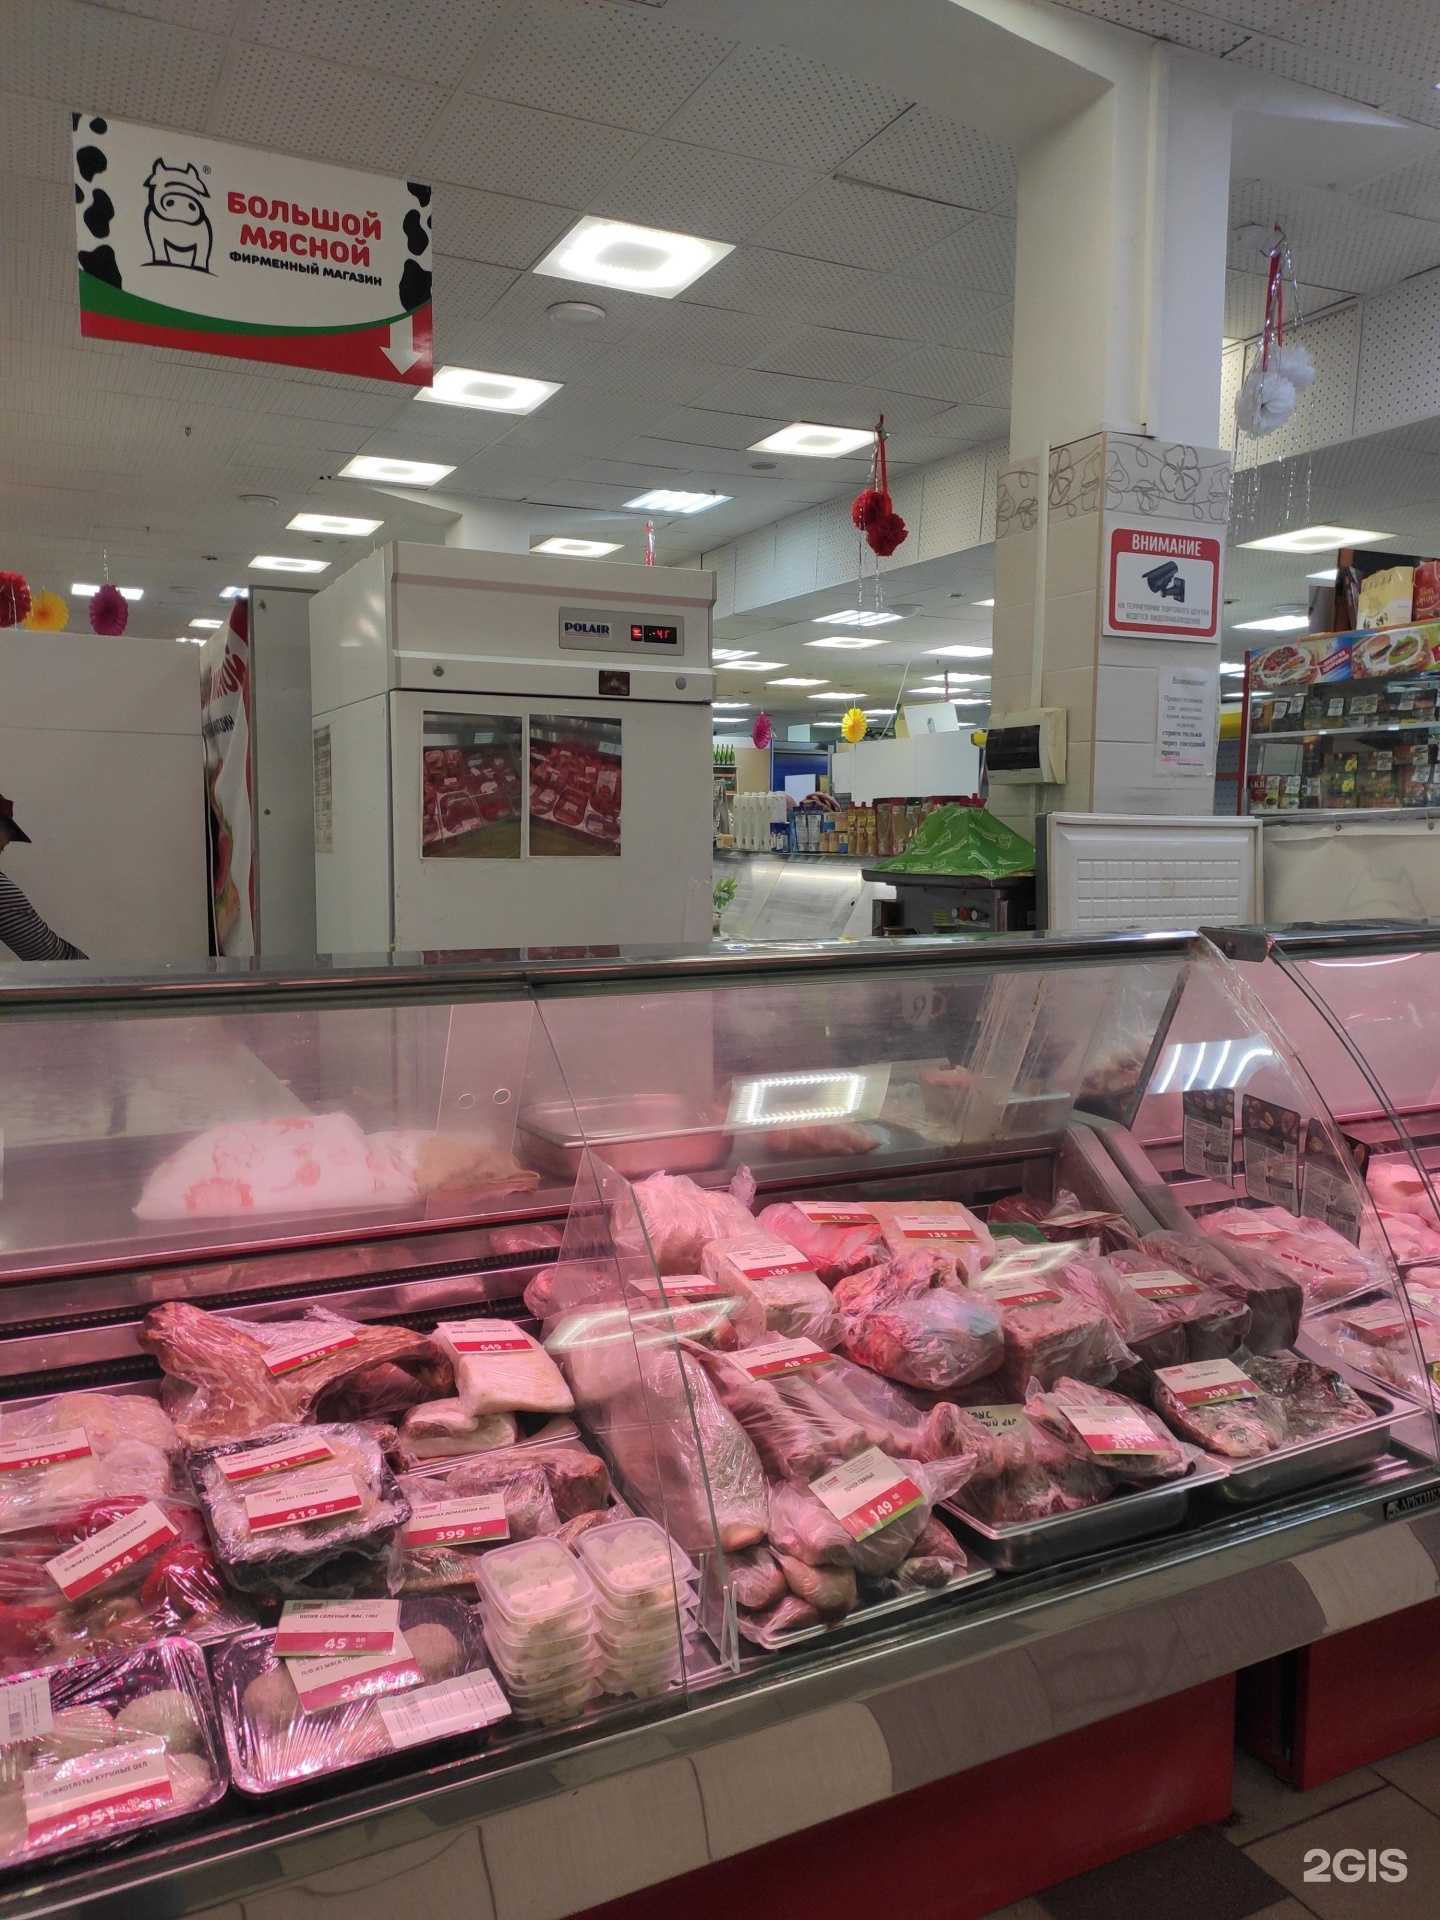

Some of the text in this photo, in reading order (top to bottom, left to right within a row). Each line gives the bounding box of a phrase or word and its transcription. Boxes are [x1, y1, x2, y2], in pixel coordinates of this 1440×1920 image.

[227, 191, 382, 241] БОЛЬШОЙ
[240, 223, 370, 268] МЯСНОЙ
[229, 251, 382, 287] ФИРМЕННЫЙ МАГАЗИН
[1131, 533, 1202, 557] ВНИМАНИЕ
[564, 622, 610, 635] POLAIR
[286, 1507, 318, 1521] 419
[435, 1528, 466, 1541] 399
[324, 1637, 347, 1650] 45
